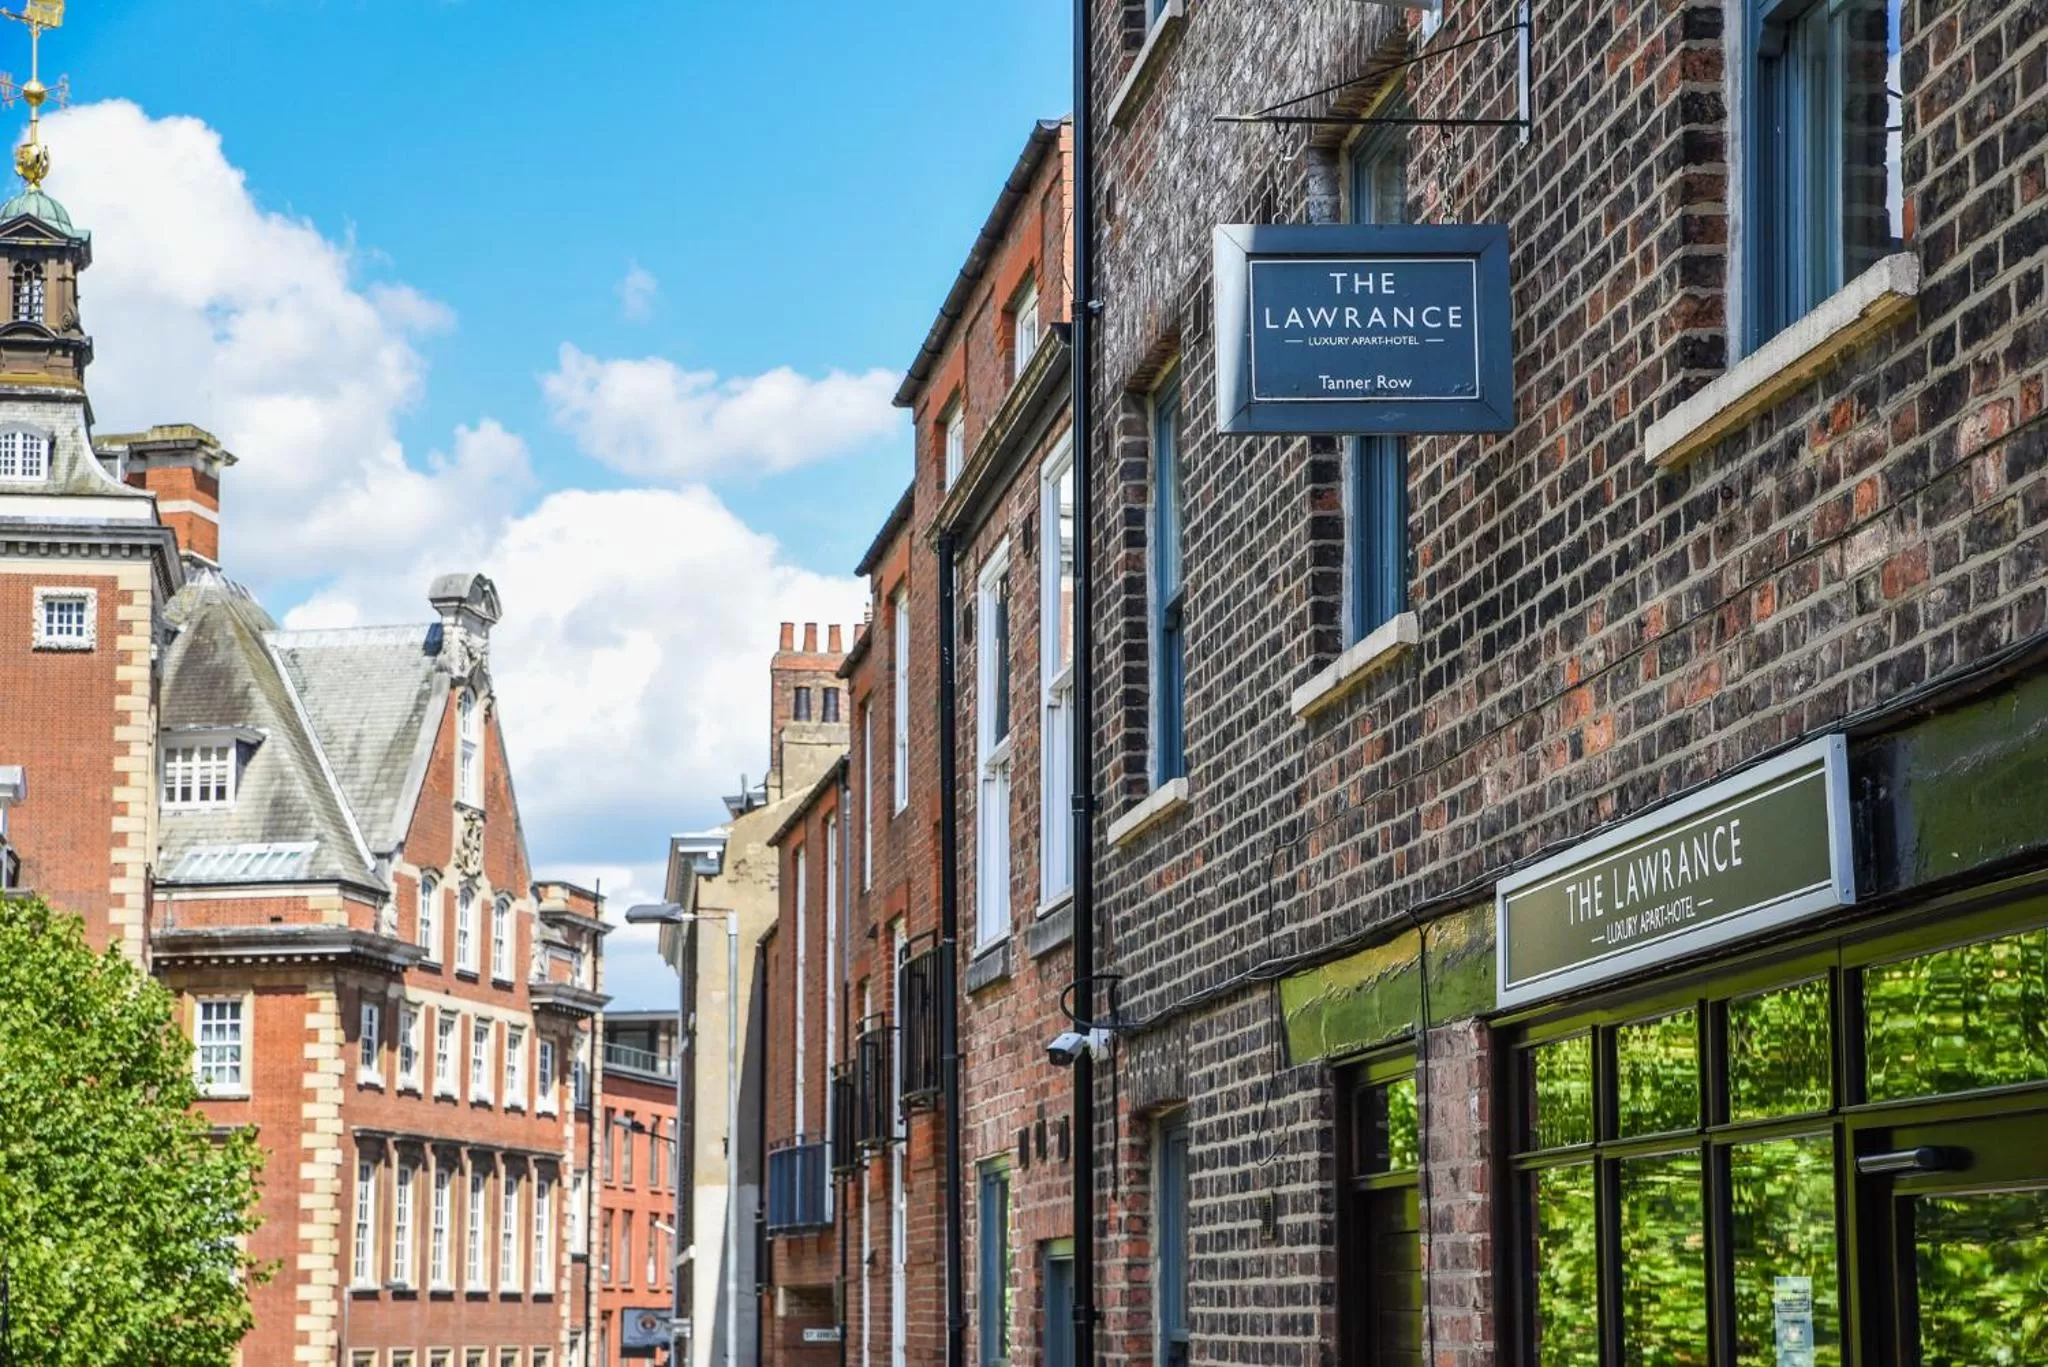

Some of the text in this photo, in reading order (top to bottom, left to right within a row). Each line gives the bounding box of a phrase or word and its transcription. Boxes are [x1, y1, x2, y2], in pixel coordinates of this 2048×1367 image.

[1329, 272, 1395, 295] THE
[1265, 306, 1463, 329] LAWRANCE
[1308, 335, 1420, 346] LUXURY APART-HOTEL
[1318, 374, 1413, 390] Tanner Row
[1566, 819, 1742, 925] THE LAWRANCE
[1606, 895, 1696, 944] LUXURY APART-HOTEL
